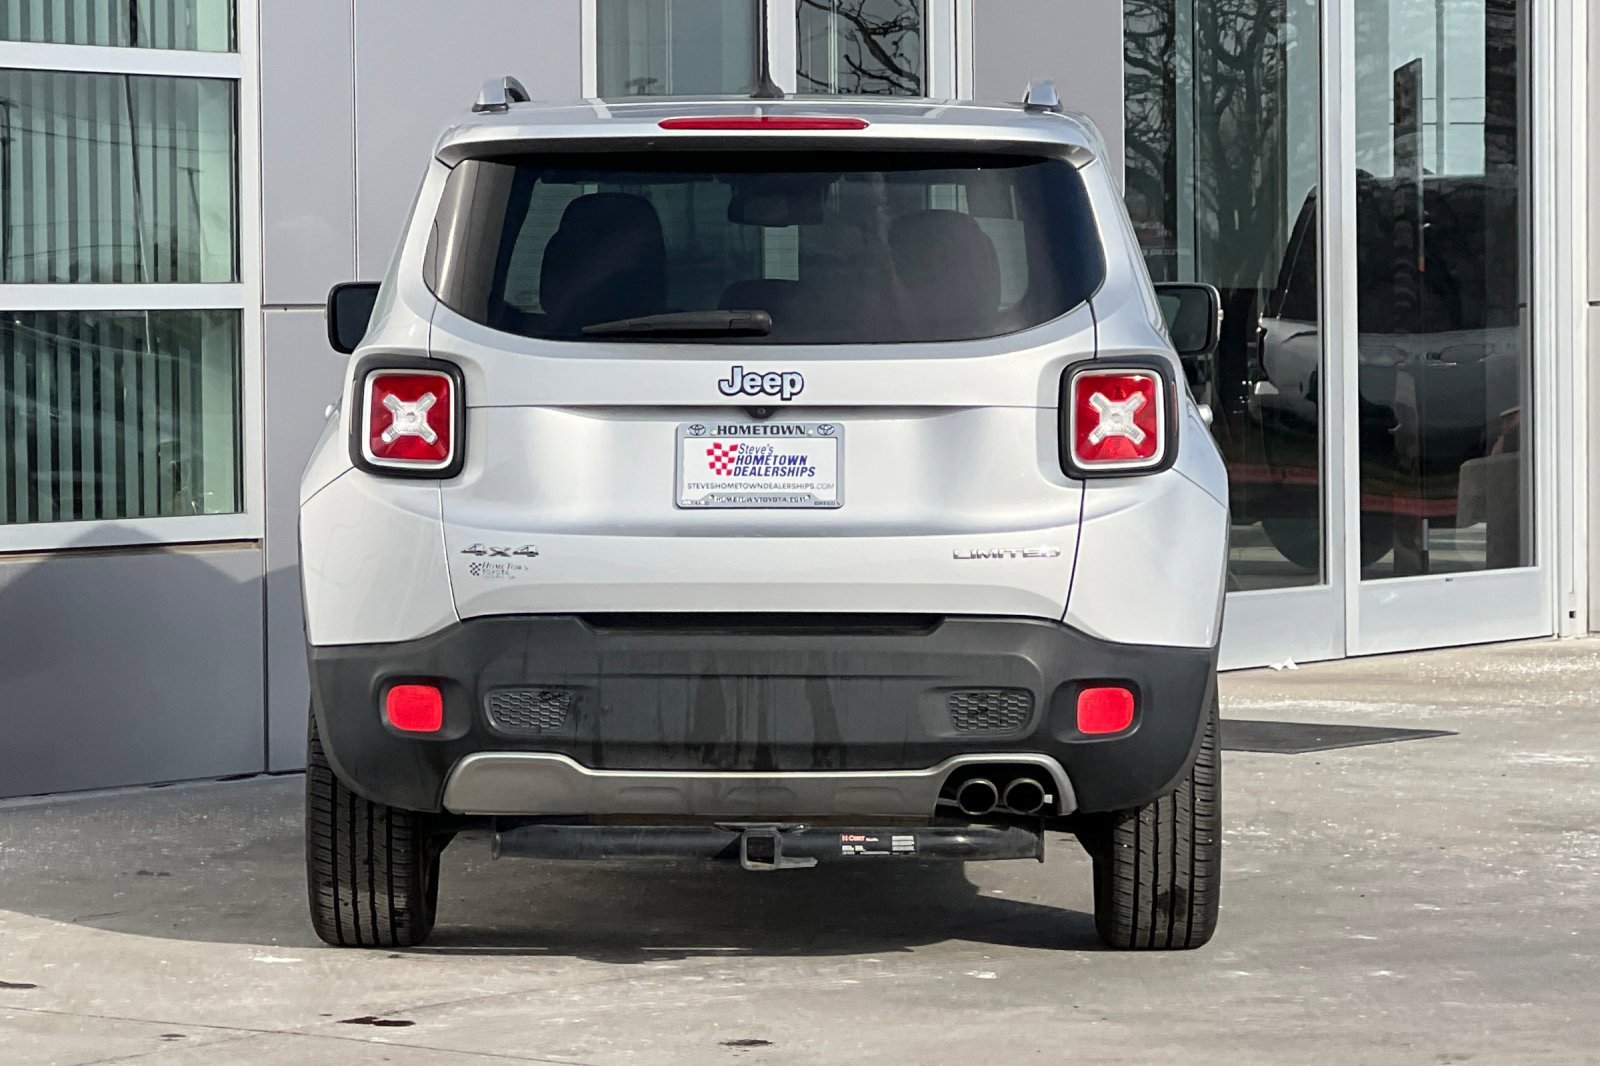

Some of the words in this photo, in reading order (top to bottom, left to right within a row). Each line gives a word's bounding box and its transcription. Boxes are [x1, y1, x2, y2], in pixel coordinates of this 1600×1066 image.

[718, 365, 804, 401] Jeep
[717, 424, 806, 436] HOMETOWN
[738, 442, 774, 455] Steve's
[735, 454, 808, 466] HOMETOWN
[733, 466, 816, 478] DEALERSHIPS
[687, 482, 835, 490] STEVESHOMETOWNDEALERSHIPS.COM
[952, 547, 1061, 560] LIMITED
